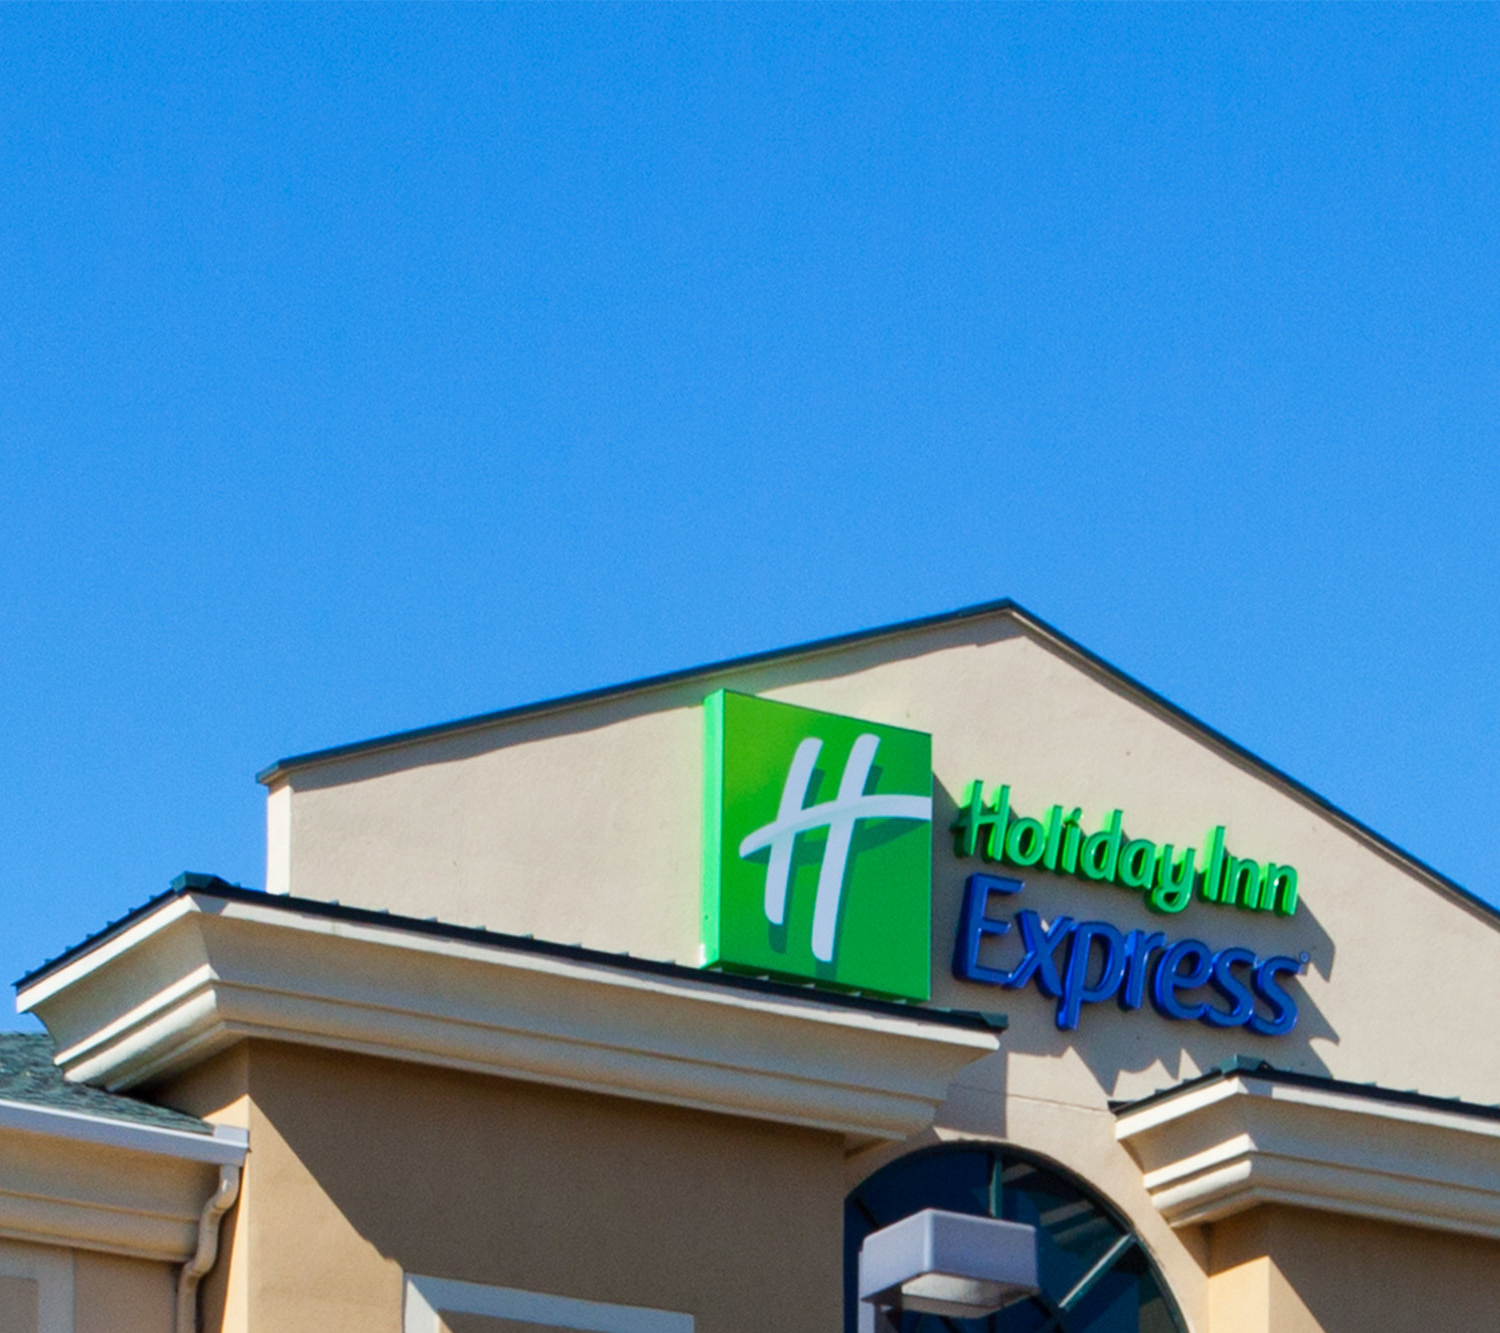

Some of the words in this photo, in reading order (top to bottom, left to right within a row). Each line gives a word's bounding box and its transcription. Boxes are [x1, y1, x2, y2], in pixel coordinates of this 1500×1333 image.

[951, 779, 1197, 915] Holiday
[1197, 825, 1299, 917] Inn
[952, 872, 1301, 1036] Express
